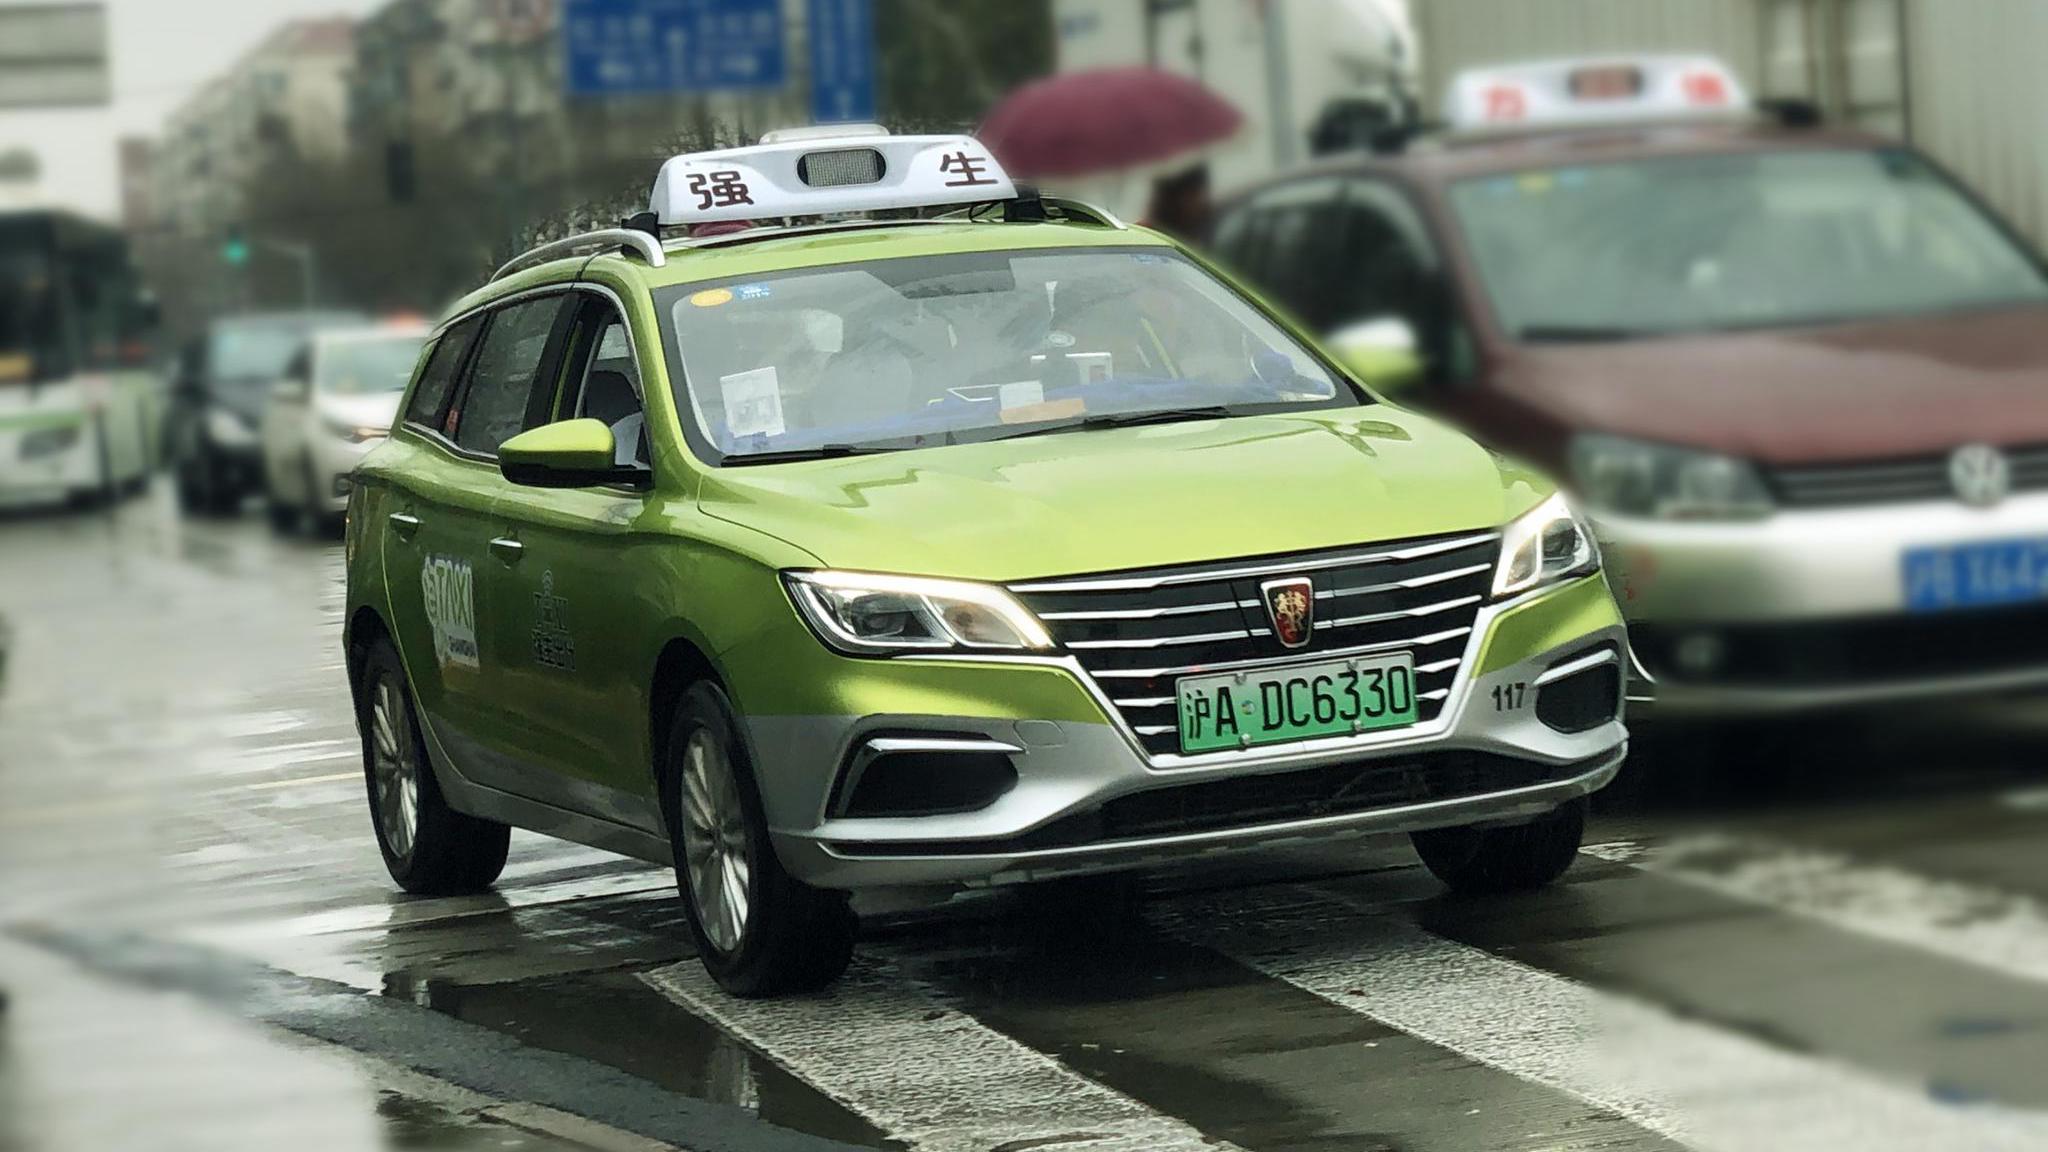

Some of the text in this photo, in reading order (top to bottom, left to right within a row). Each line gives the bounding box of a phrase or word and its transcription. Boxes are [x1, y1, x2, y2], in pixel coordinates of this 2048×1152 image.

[685, 151, 999, 211] 强 生
[1261, 665, 1411, 732] DC6330
[1491, 682, 1526, 712] 117
